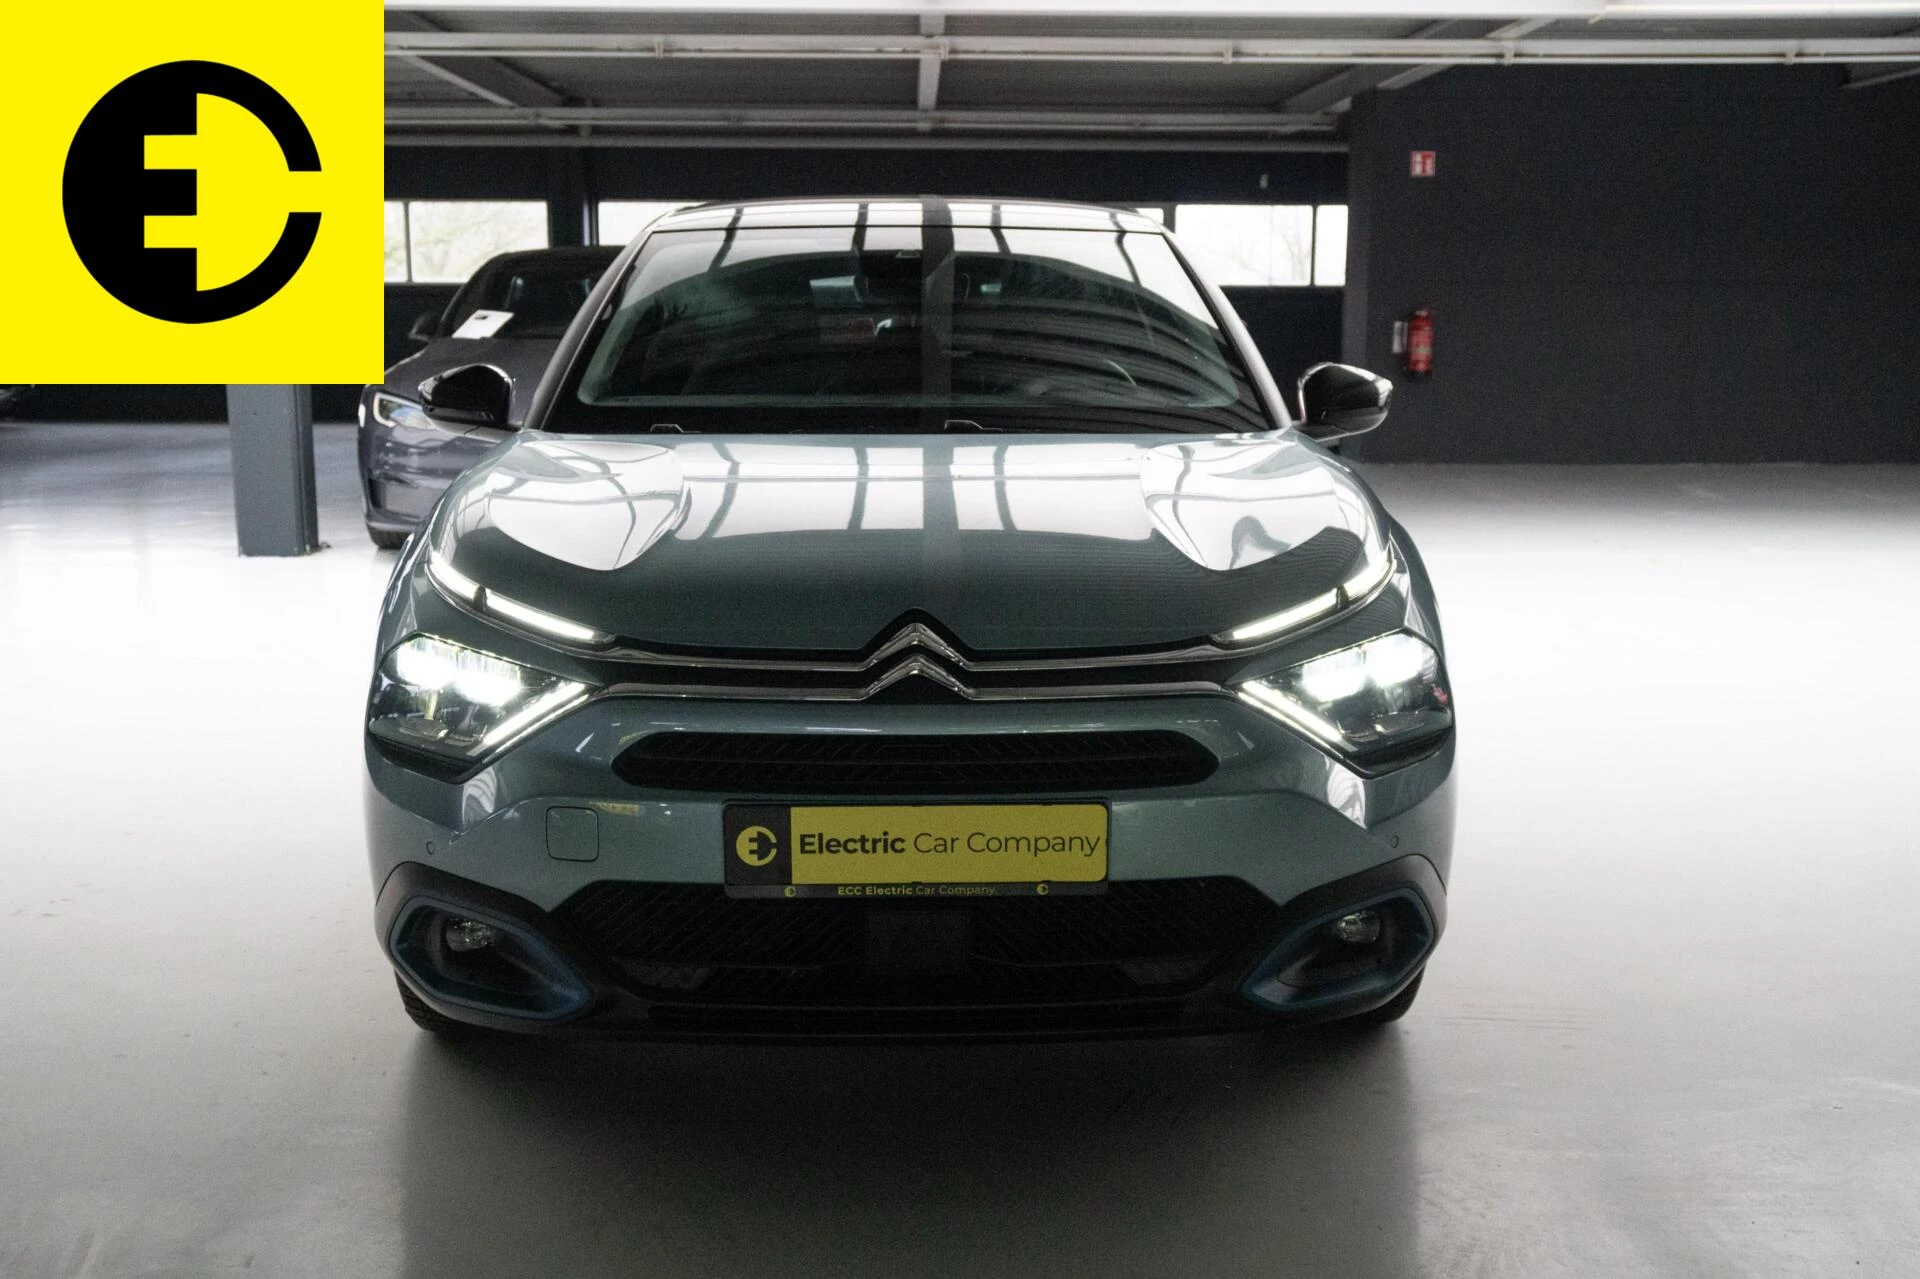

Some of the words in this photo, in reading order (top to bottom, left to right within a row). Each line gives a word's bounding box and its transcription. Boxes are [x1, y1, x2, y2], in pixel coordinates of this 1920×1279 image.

[800, 831, 906, 855] Electric
[913, 832, 959, 854] Car
[966, 832, 1101, 857] Company
[837, 886, 861, 896] ECC
[866, 886, 912, 896] Electric
[916, 886, 935, 896] Car
[938, 886, 995, 897] Company
